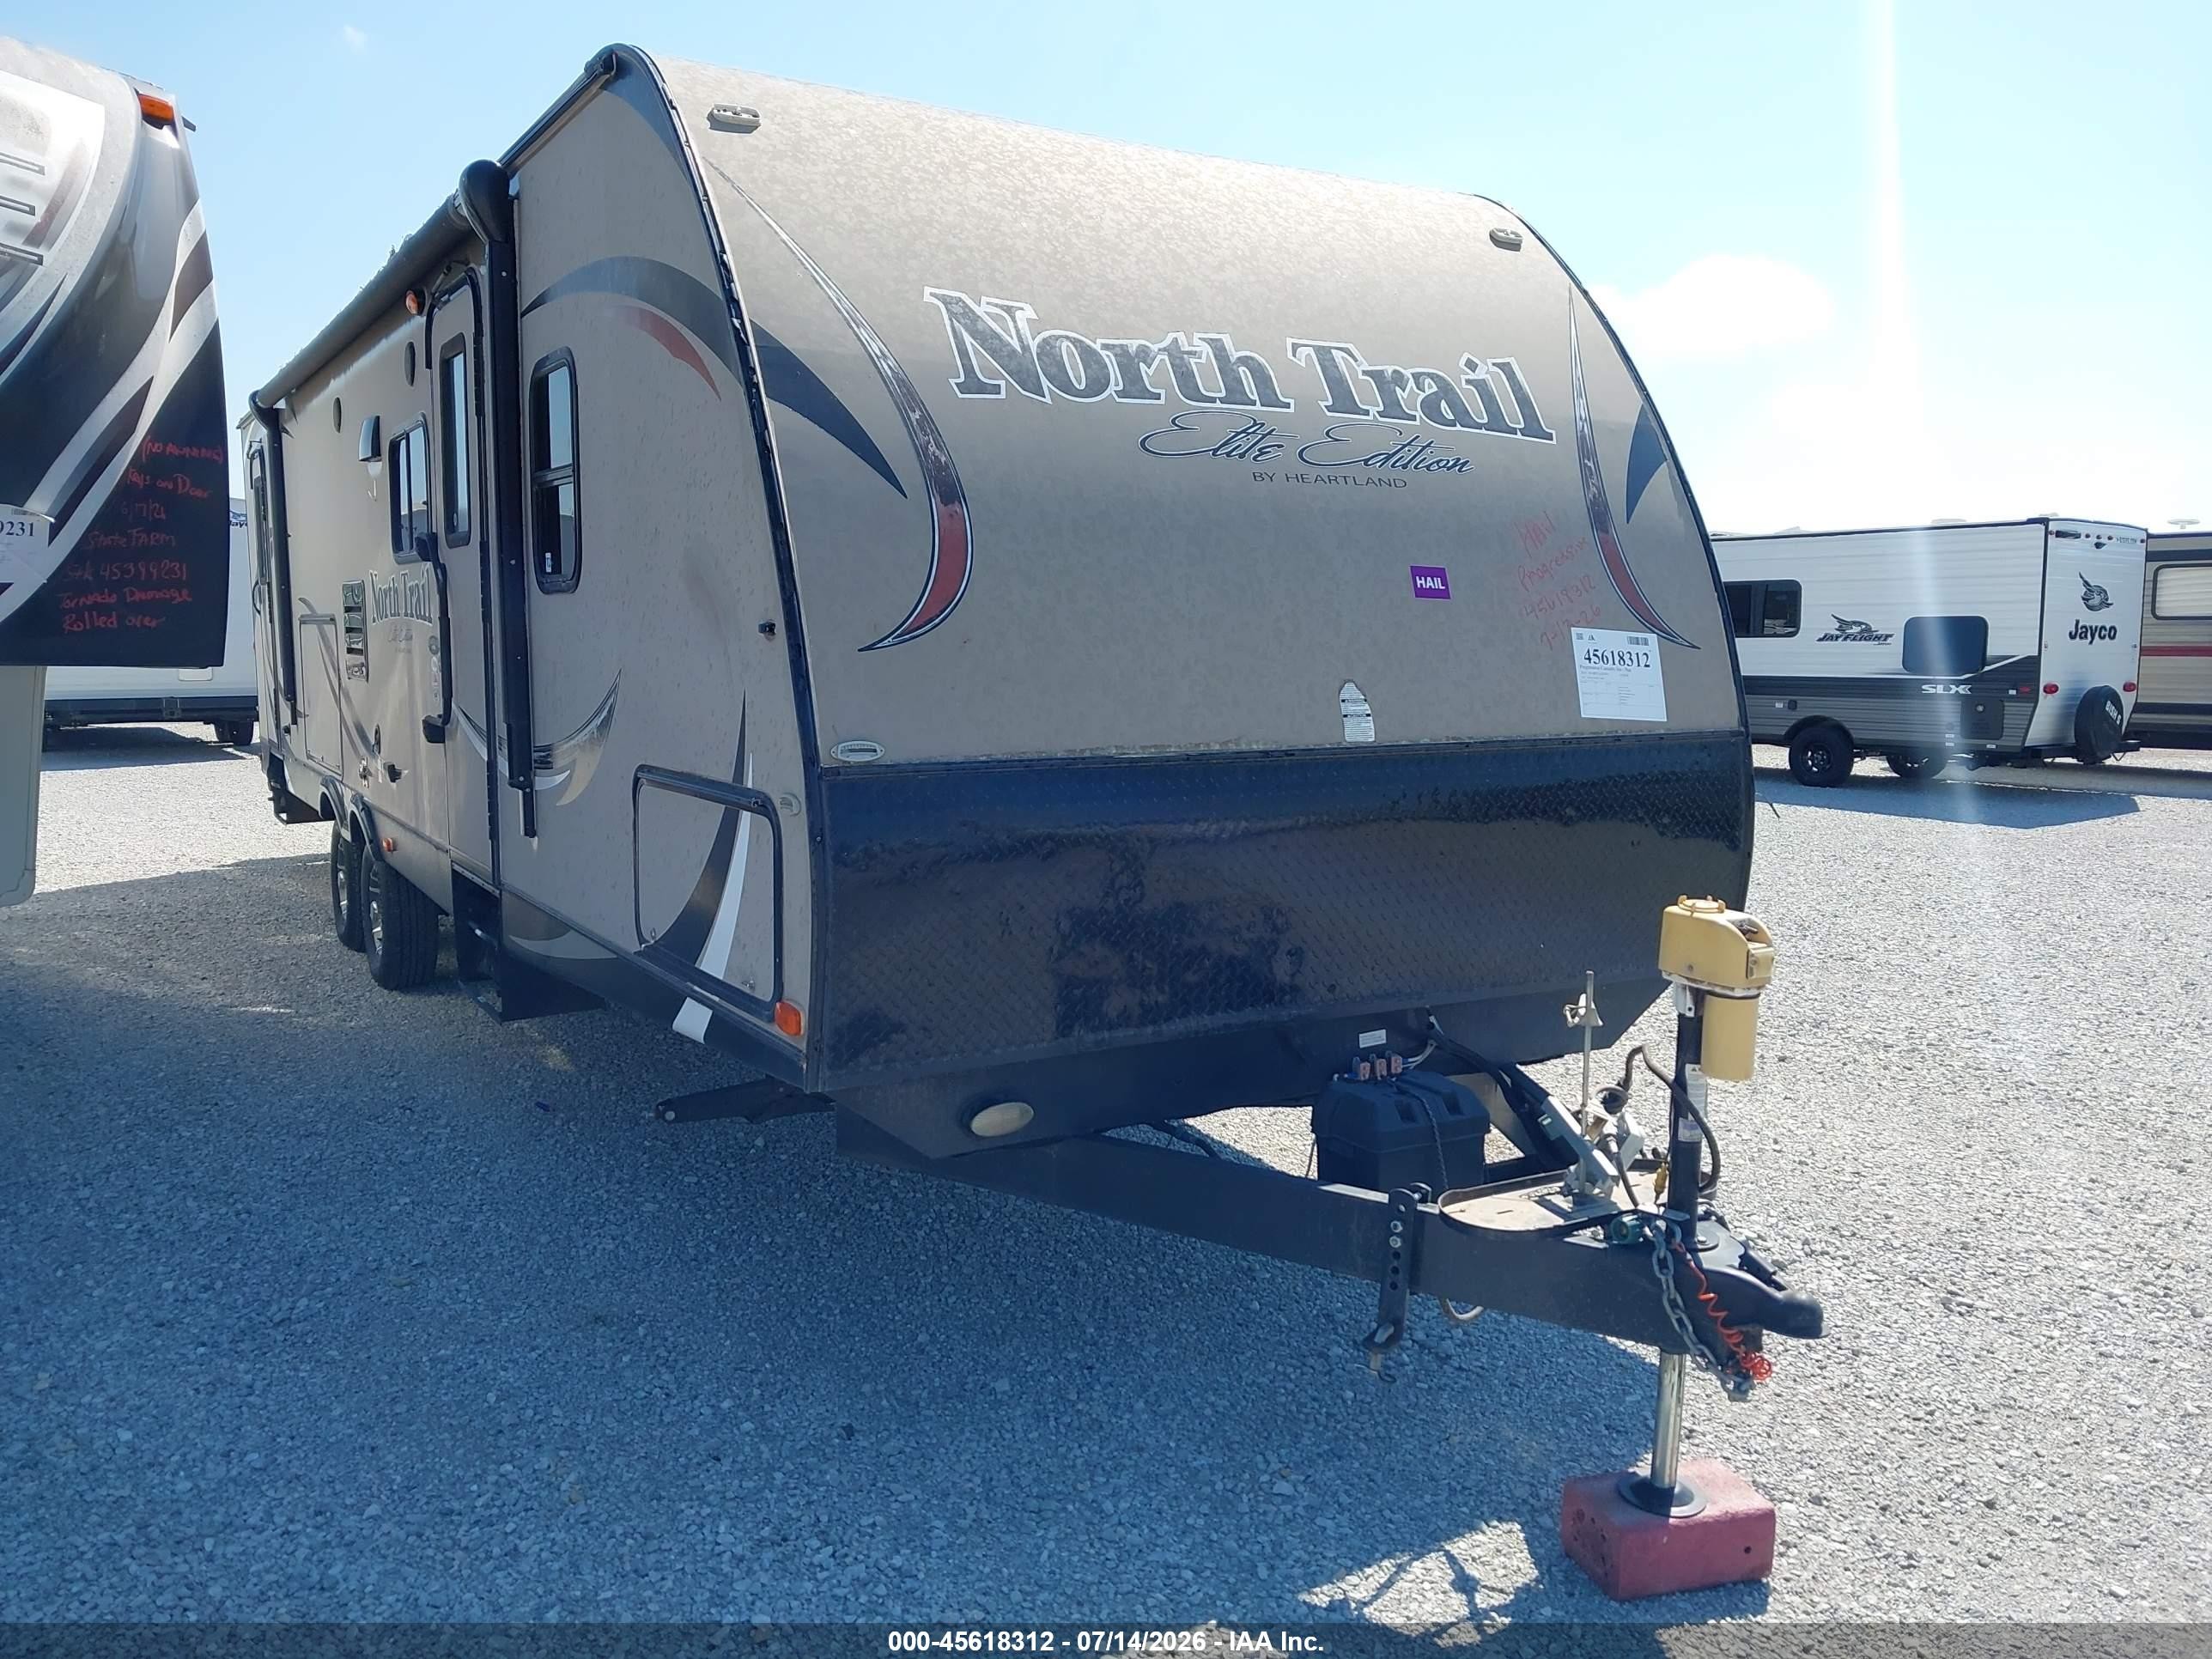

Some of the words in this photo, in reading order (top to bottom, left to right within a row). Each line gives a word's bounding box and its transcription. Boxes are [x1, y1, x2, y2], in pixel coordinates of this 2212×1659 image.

[923, 286, 1294, 412] North
[1287, 337, 1556, 444] Trail
[1139, 410, 1300, 465] Elite
[1297, 422, 1475, 475] Edition
[1252, 471, 1276, 483] BY
[1285, 473, 1407, 488] HEARTLAND
[1415, 575, 1446, 589] HAIL
[369, 570, 400, 625] North
[399, 561, 433, 627] Trail
[1815, 633, 1843, 641] JAY
[1840, 633, 1896, 642] FLIGHT
[2068, 618, 2118, 645] Jayco
[1583, 647, 1650, 667] 45618312
[1921, 684, 1972, 695] SLX
